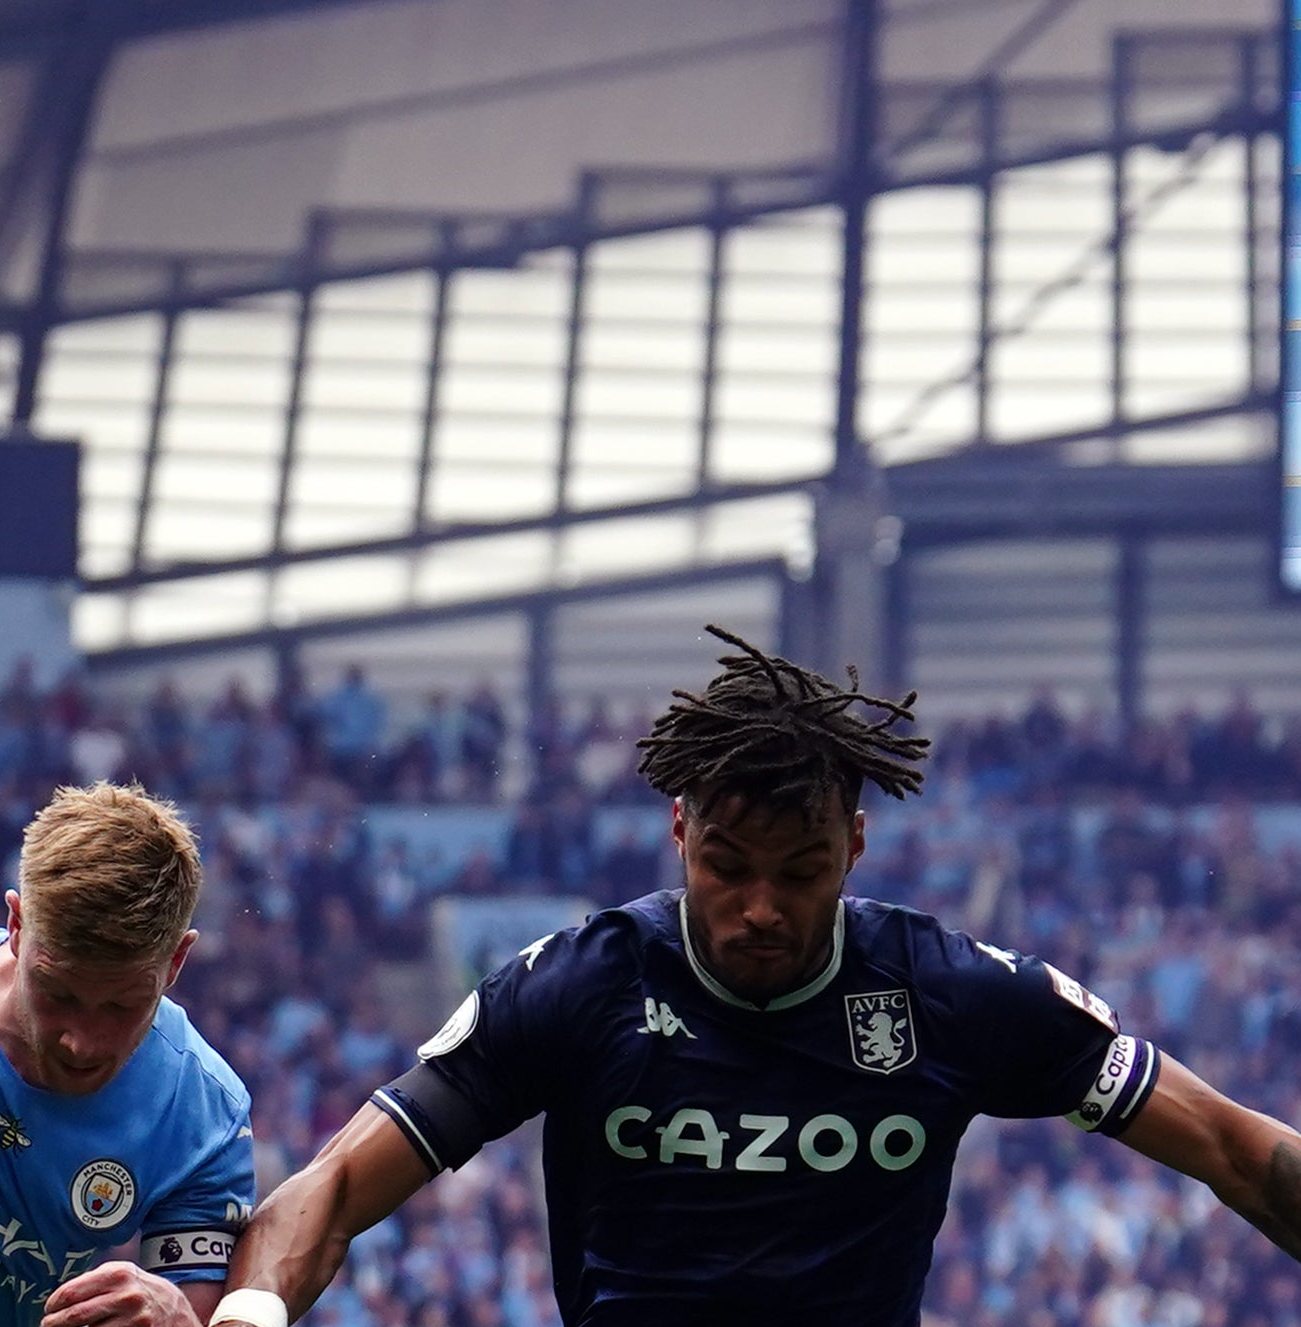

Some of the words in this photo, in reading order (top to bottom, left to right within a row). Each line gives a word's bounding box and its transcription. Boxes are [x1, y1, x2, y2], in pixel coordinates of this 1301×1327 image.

[851, 994, 906, 1014] AVFC
[604, 1105, 927, 1172] CAZOO
[83, 1163, 133, 1196] MANCHESTER
[82, 1214, 100, 1227] CITY
